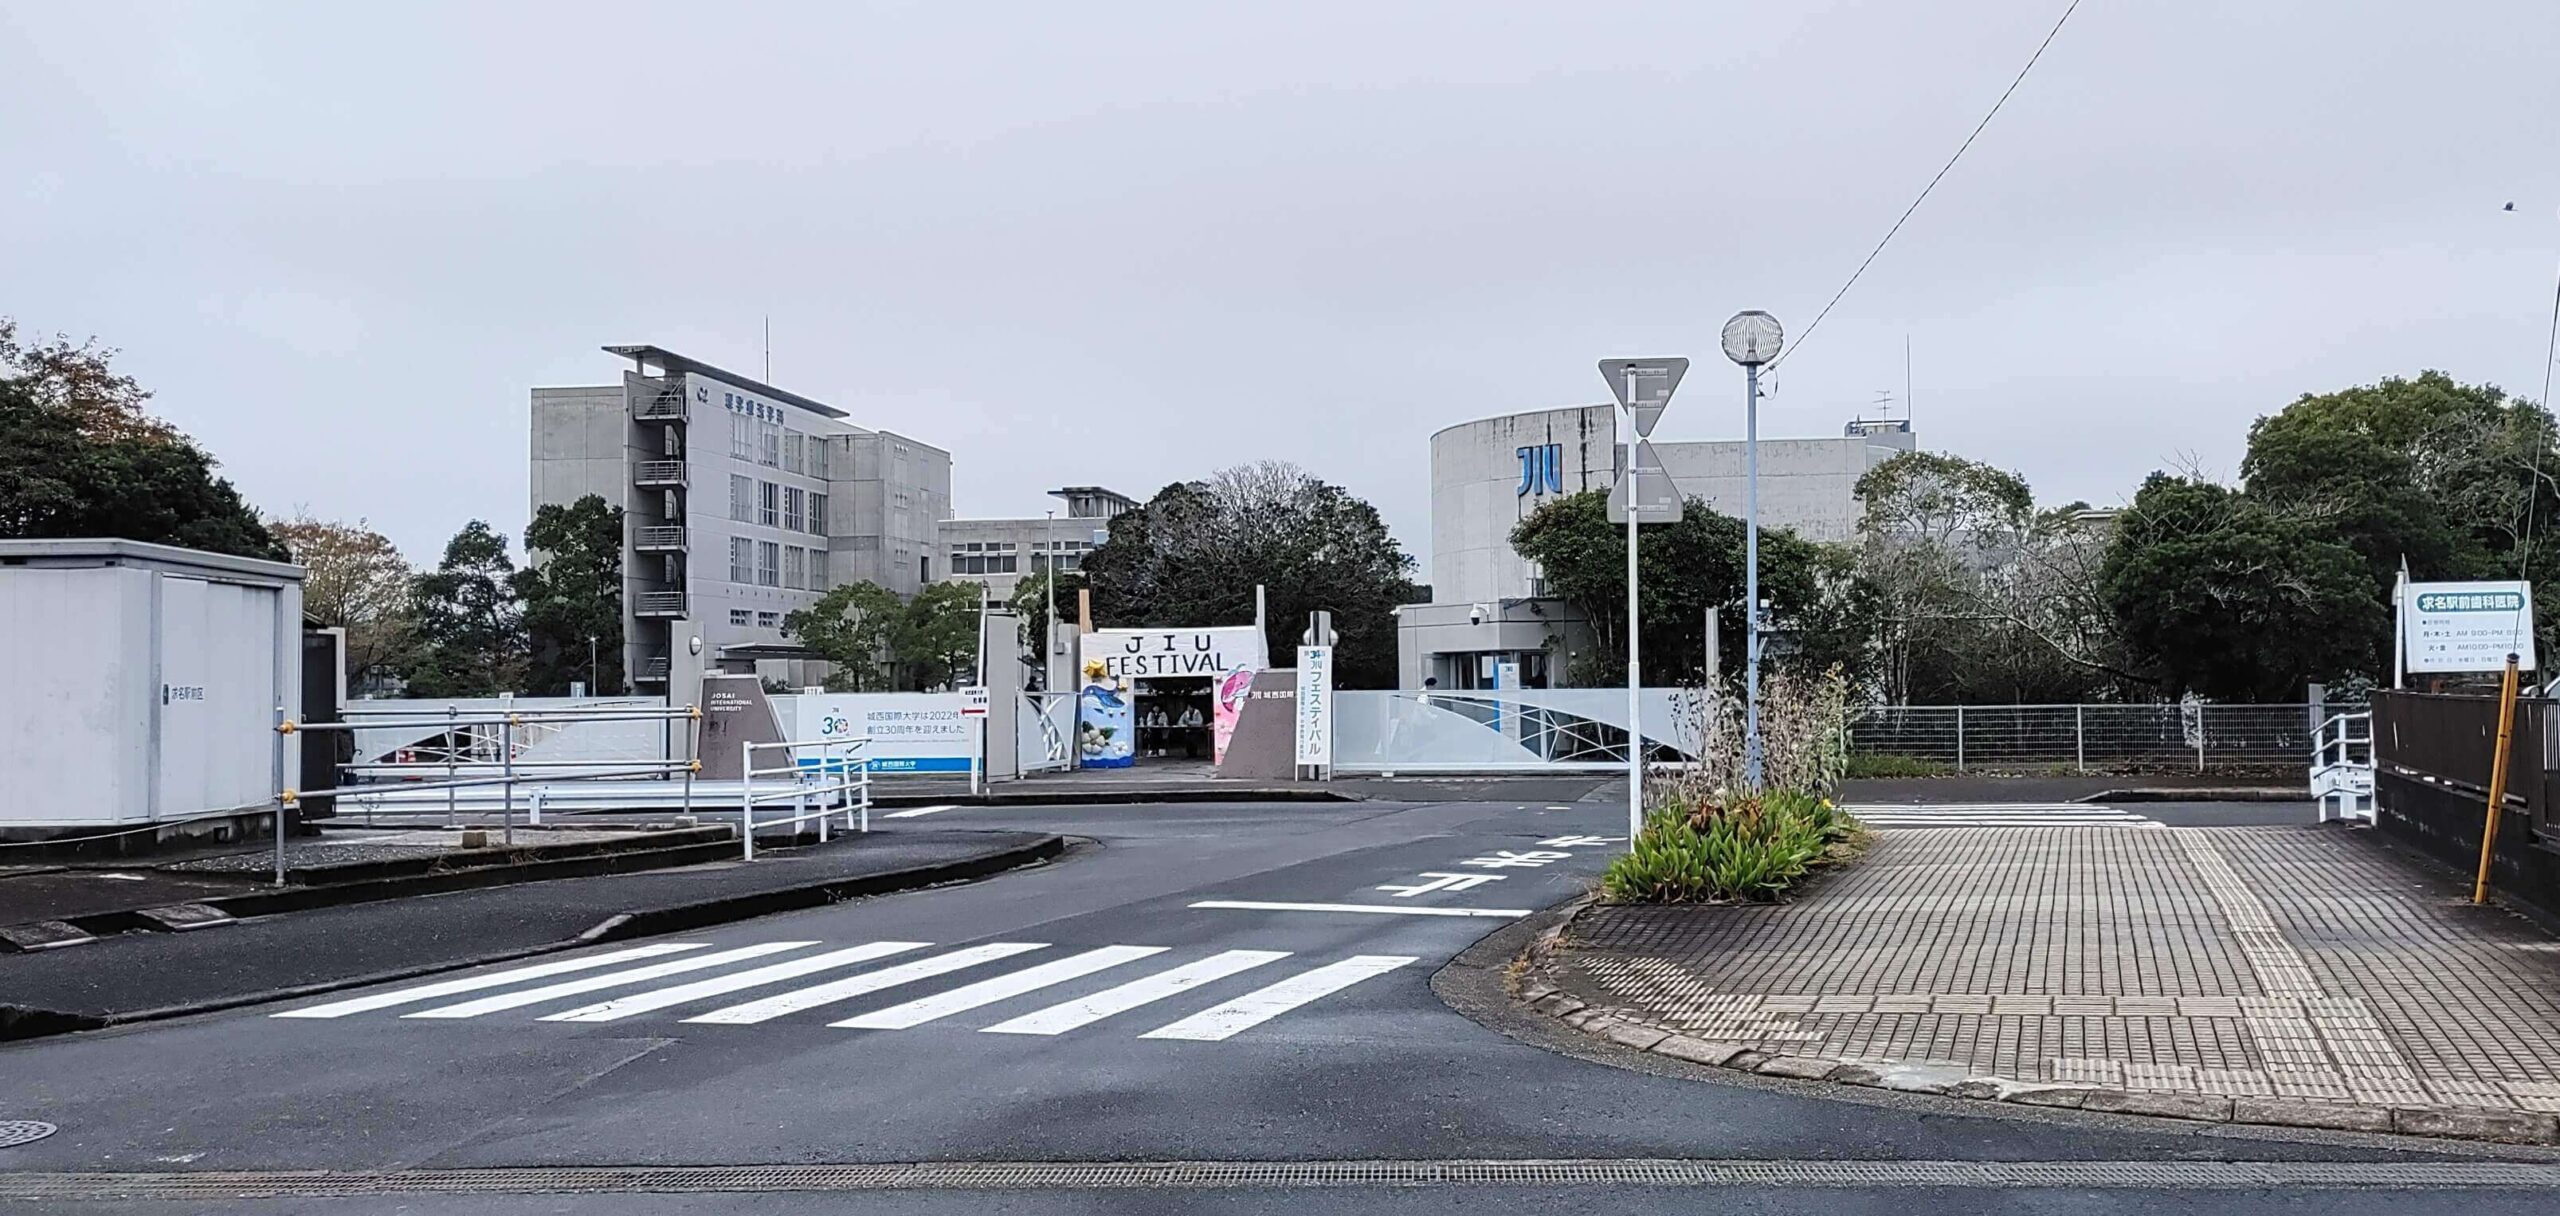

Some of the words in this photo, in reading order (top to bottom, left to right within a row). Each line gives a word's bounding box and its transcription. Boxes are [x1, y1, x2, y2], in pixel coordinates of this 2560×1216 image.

[1516, 443, 1563, 495] JIU
[2422, 595, 2519, 610] 求名駅前歯科医院
[1106, 653, 1229, 676] FESTIVAL
[1263, 690, 1297, 699] 城西国際
[1309, 671, 1322, 755] フェスティバル
[867, 724, 965, 735] 創立30周年を迎えました
